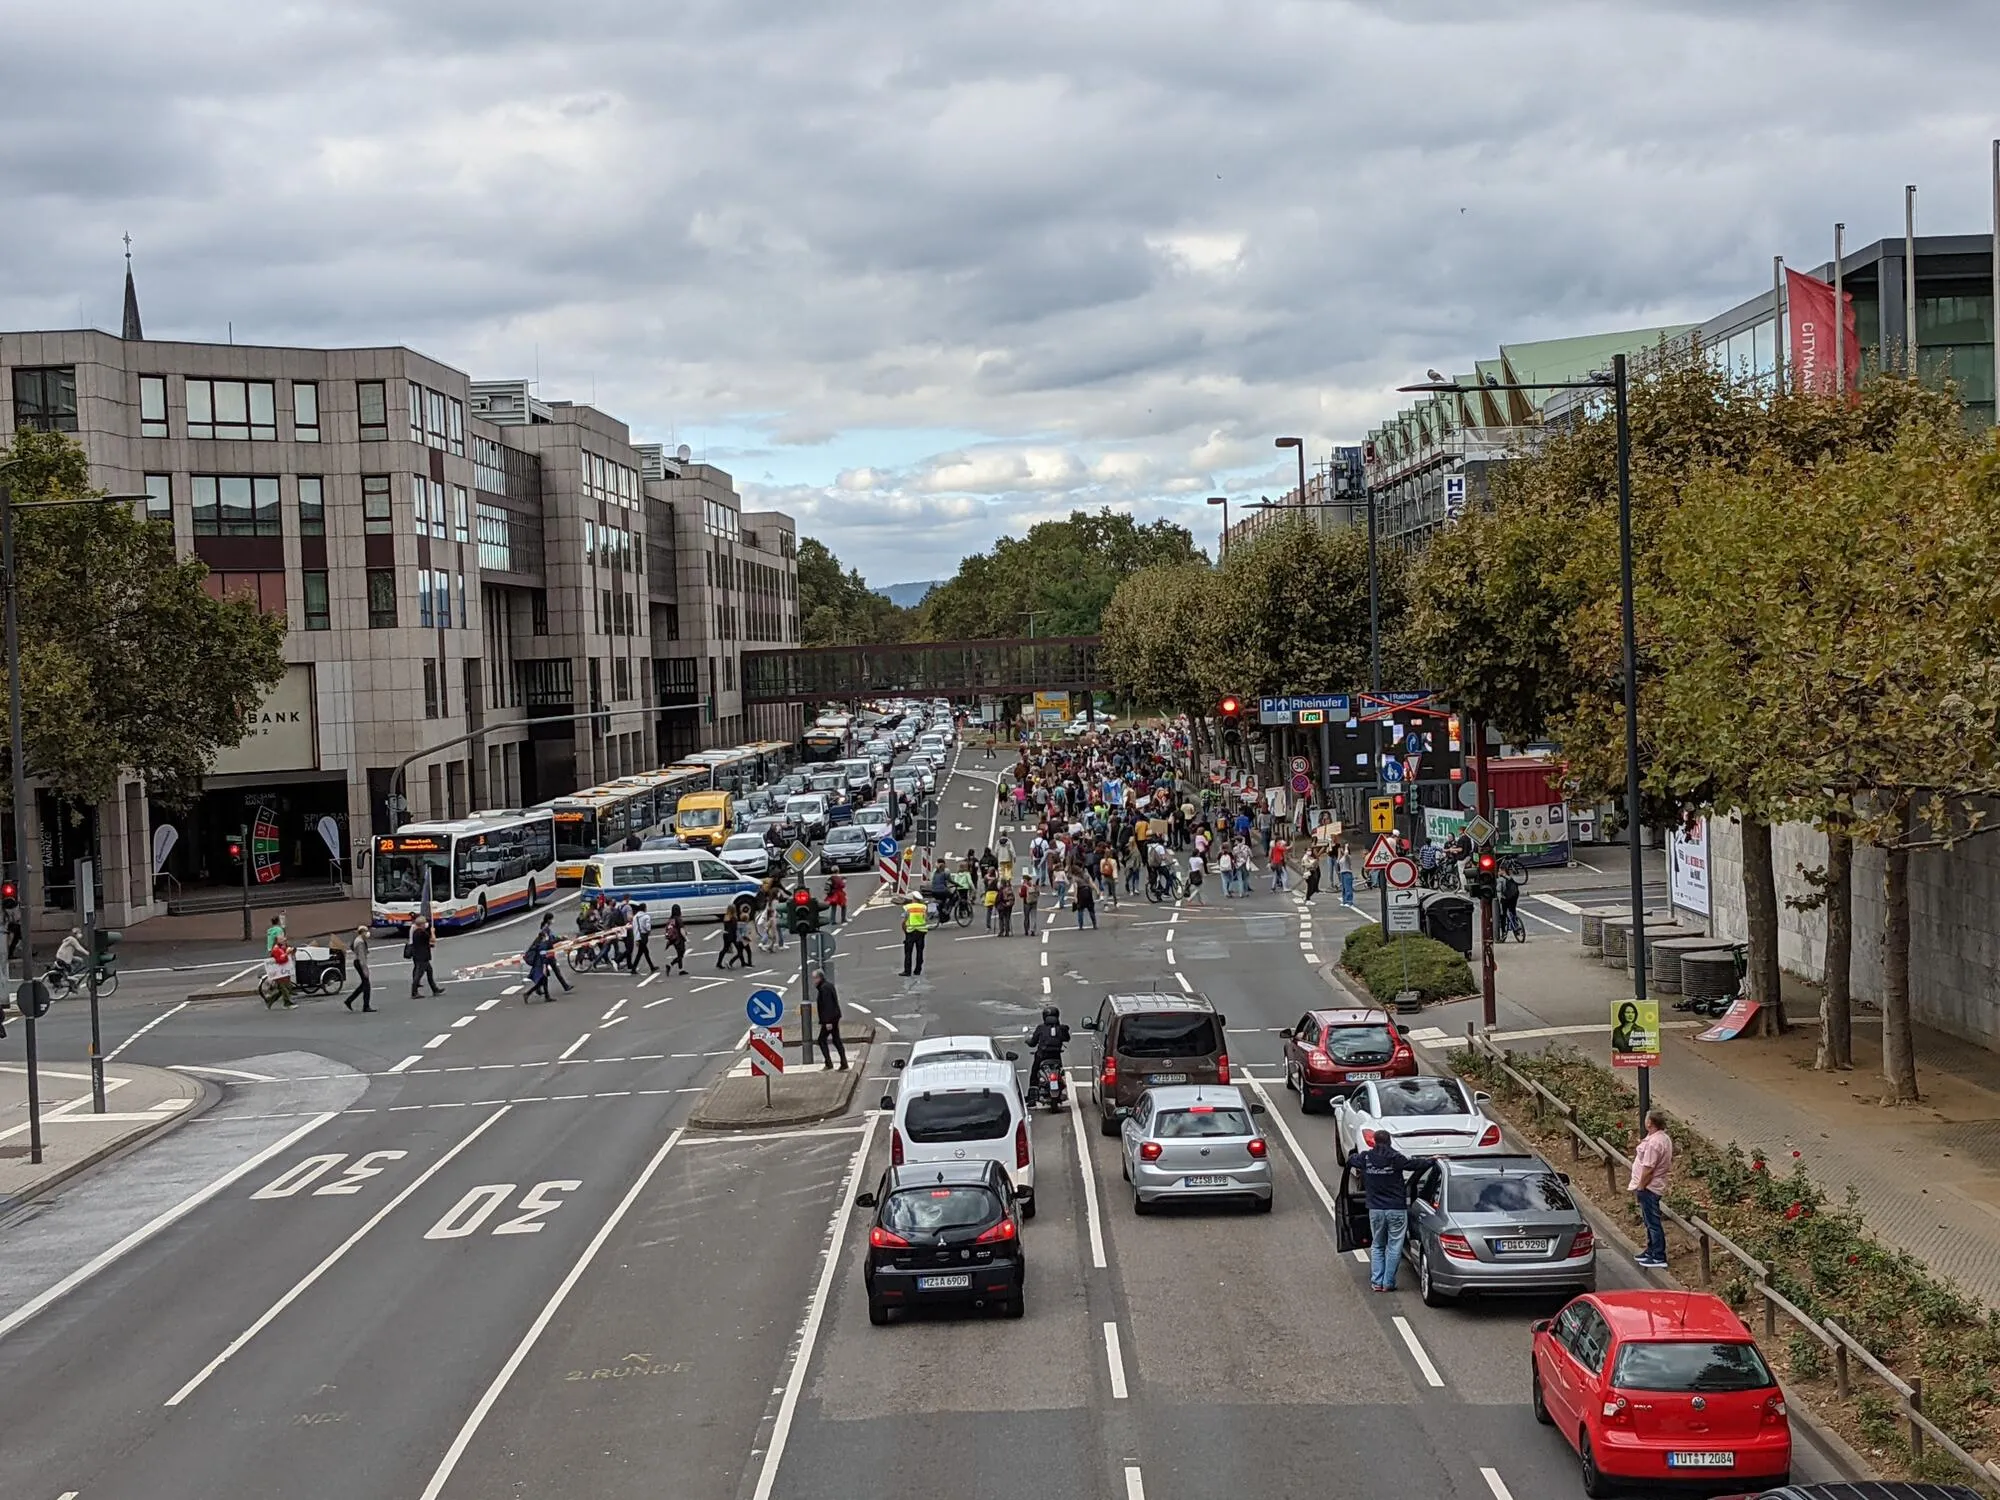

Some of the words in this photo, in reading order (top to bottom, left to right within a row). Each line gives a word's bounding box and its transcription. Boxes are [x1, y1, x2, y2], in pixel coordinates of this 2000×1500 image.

[1802, 322, 1816, 394] CITYMAR
[1263, 700, 1273, 711] P
[1292, 698, 1342, 709] Rheinufer
[248, 712, 300, 724] BANK
[1294, 761, 1305, 770] 30
[380, 839, 394, 850] 28
[257, 855, 266, 866] 26
[423, 1180, 584, 1239] 30
[1502, 1240, 1513, 1249] FD
[1525, 1239, 1546, 1249] 9298
[923, 1278, 935, 1287] MZ
[947, 1276, 967, 1285] 6909
[1675, 1453, 1694, 1464] TUT
[1708, 1452, 1731, 1463] 2084
